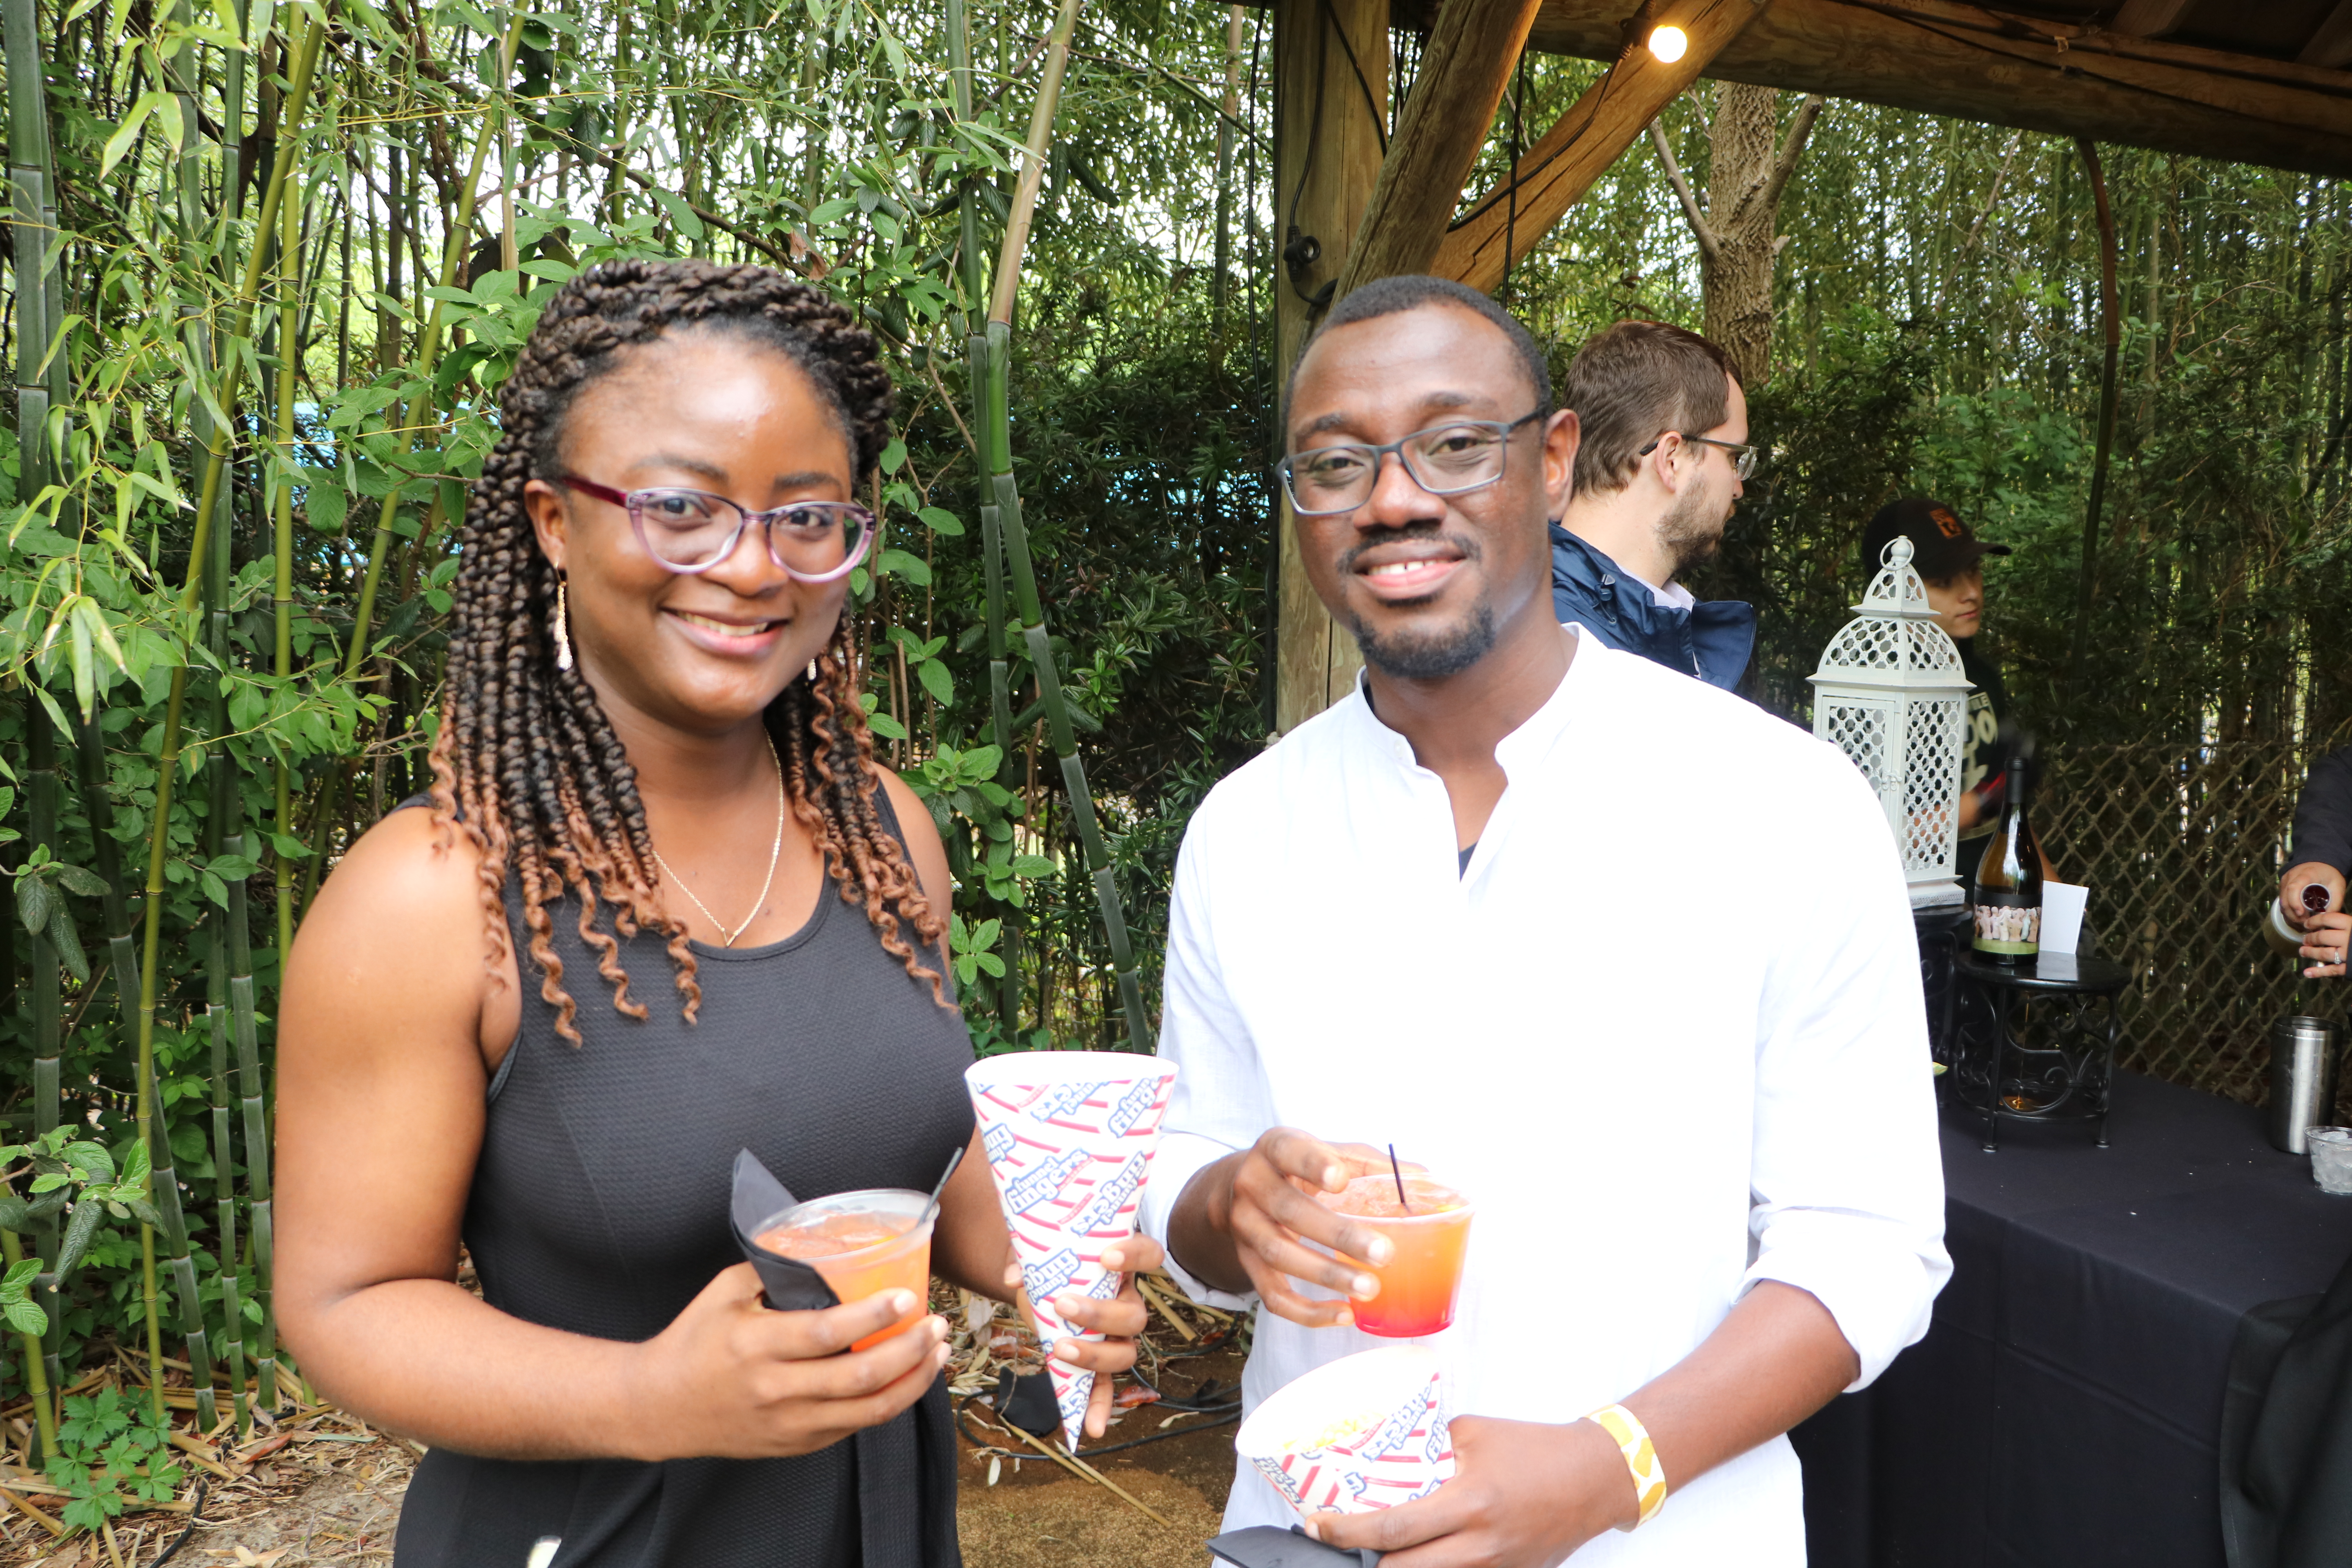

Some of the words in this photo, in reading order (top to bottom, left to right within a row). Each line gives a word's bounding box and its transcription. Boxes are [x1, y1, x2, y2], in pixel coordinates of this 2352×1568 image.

[1006, 1150, 1089, 1214] fingers
[1013, 1156, 1059, 1191] funnel
[1071, 1152, 1146, 1236] fingers
[1101, 1180, 1138, 1224] funnel
[1029, 1276, 1069, 1304] funnel
[1392, 1400, 1427, 1450] funnel
